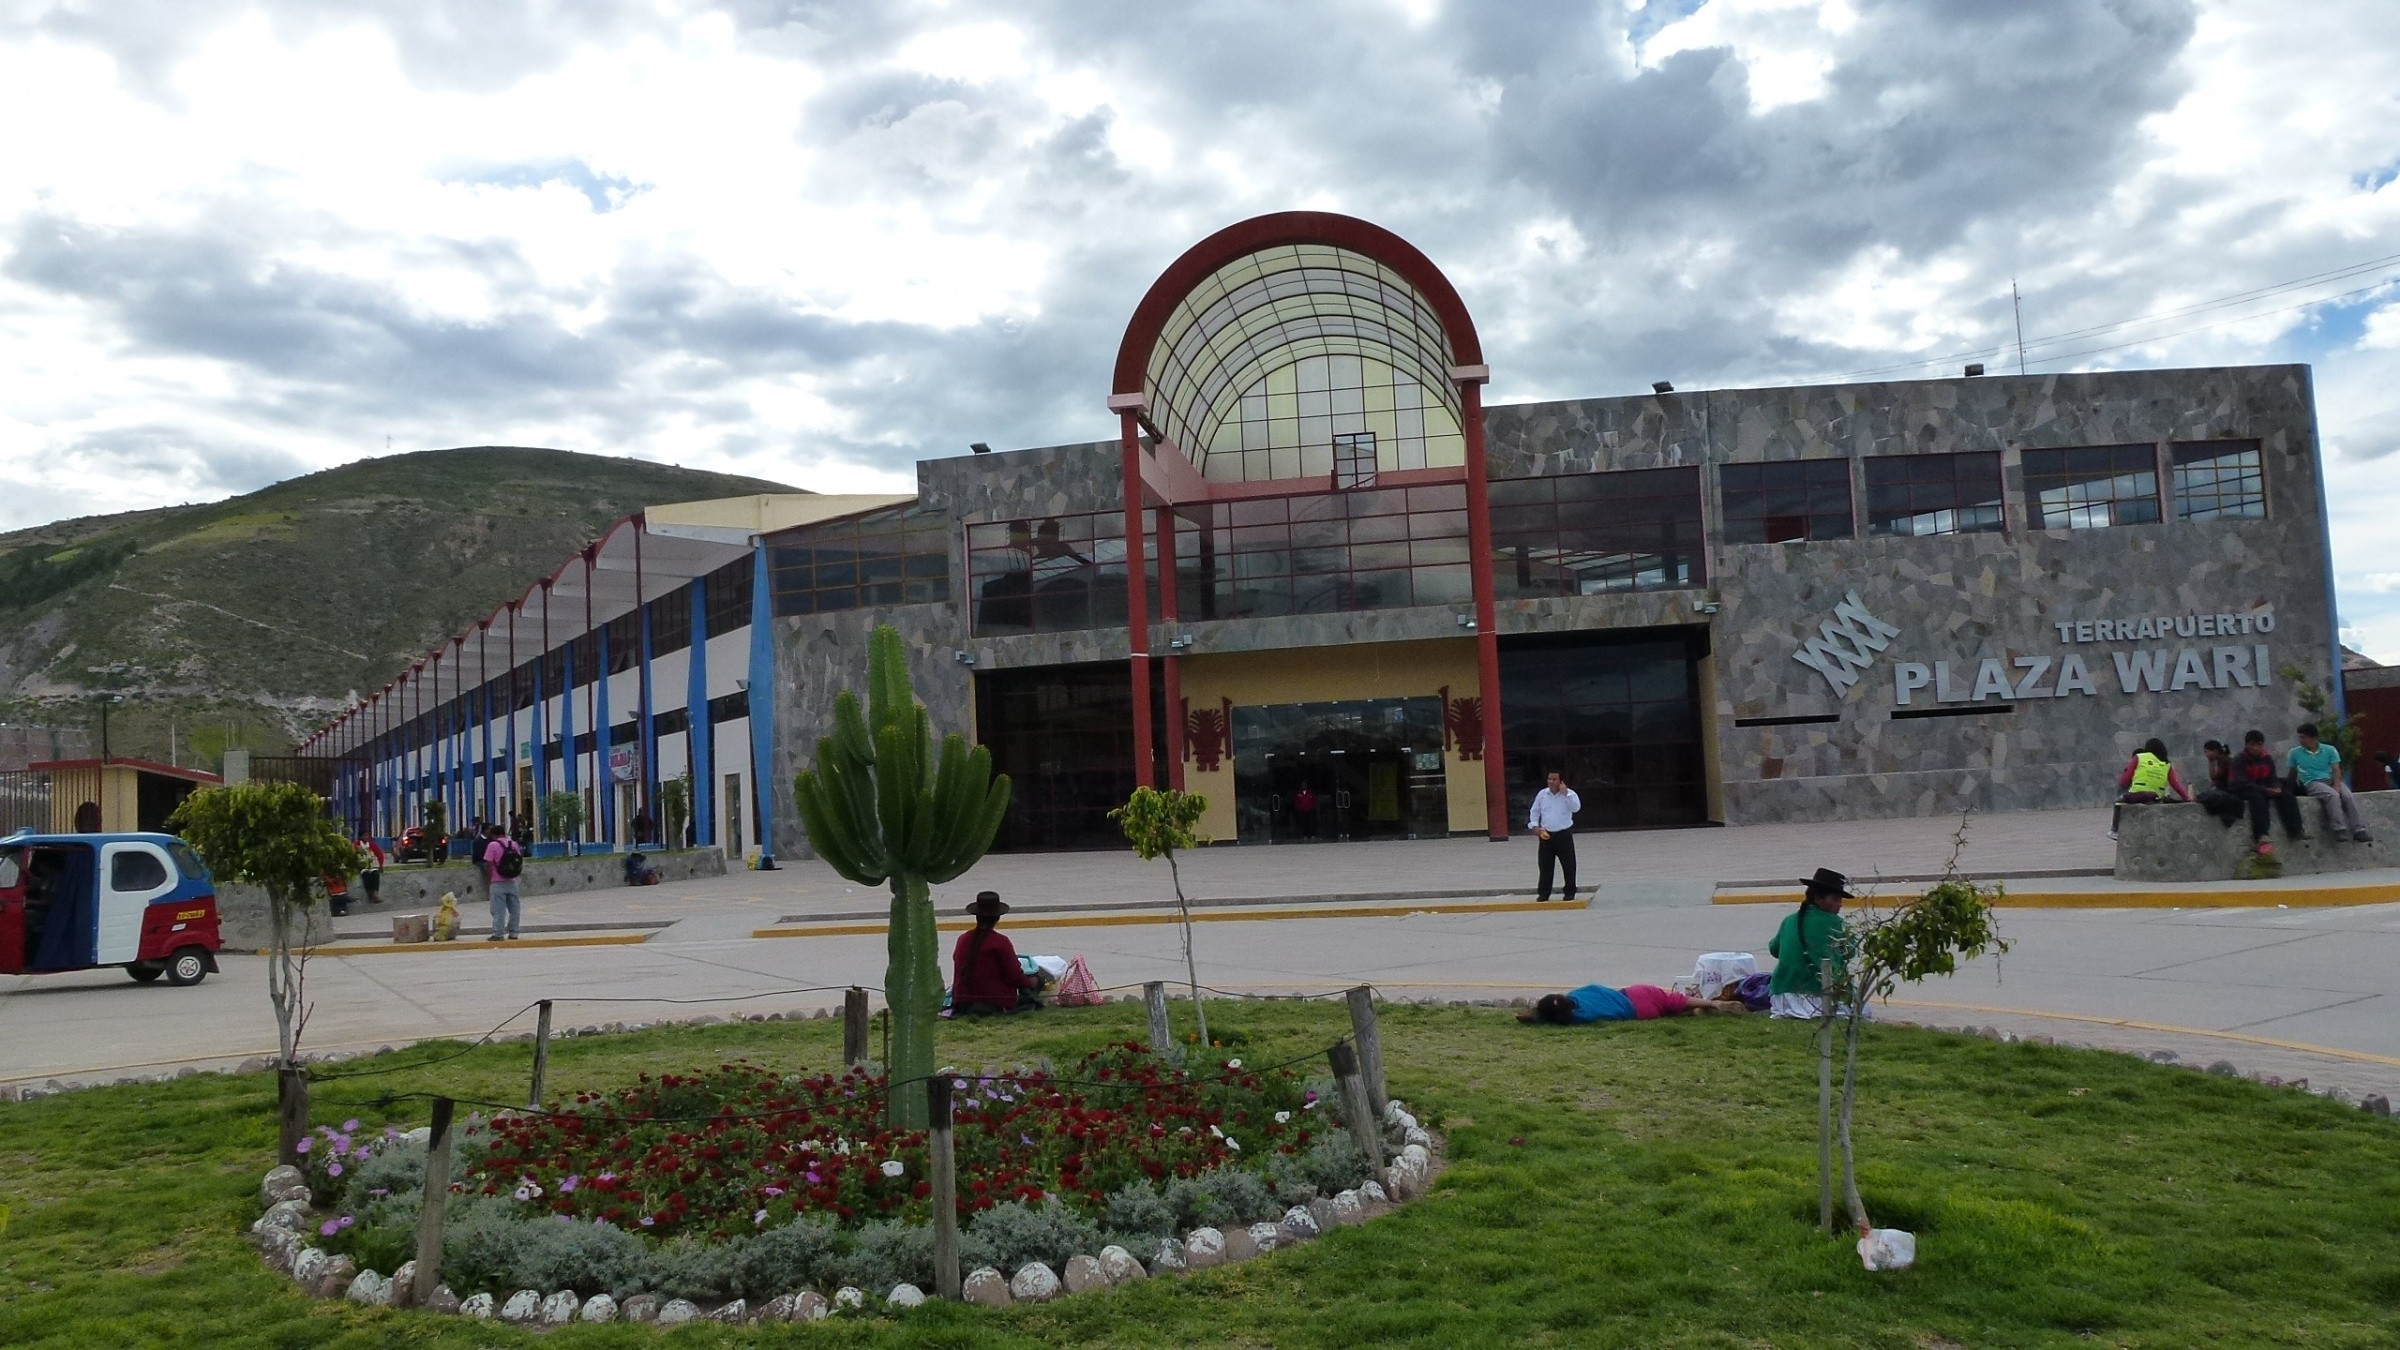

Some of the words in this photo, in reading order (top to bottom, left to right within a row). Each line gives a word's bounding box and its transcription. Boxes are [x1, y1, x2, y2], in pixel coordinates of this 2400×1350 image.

[2055, 612, 2275, 643] TERRAPUERTO
[1895, 654, 2097, 704] PLAZA
[2112, 644, 2271, 693] WARI
